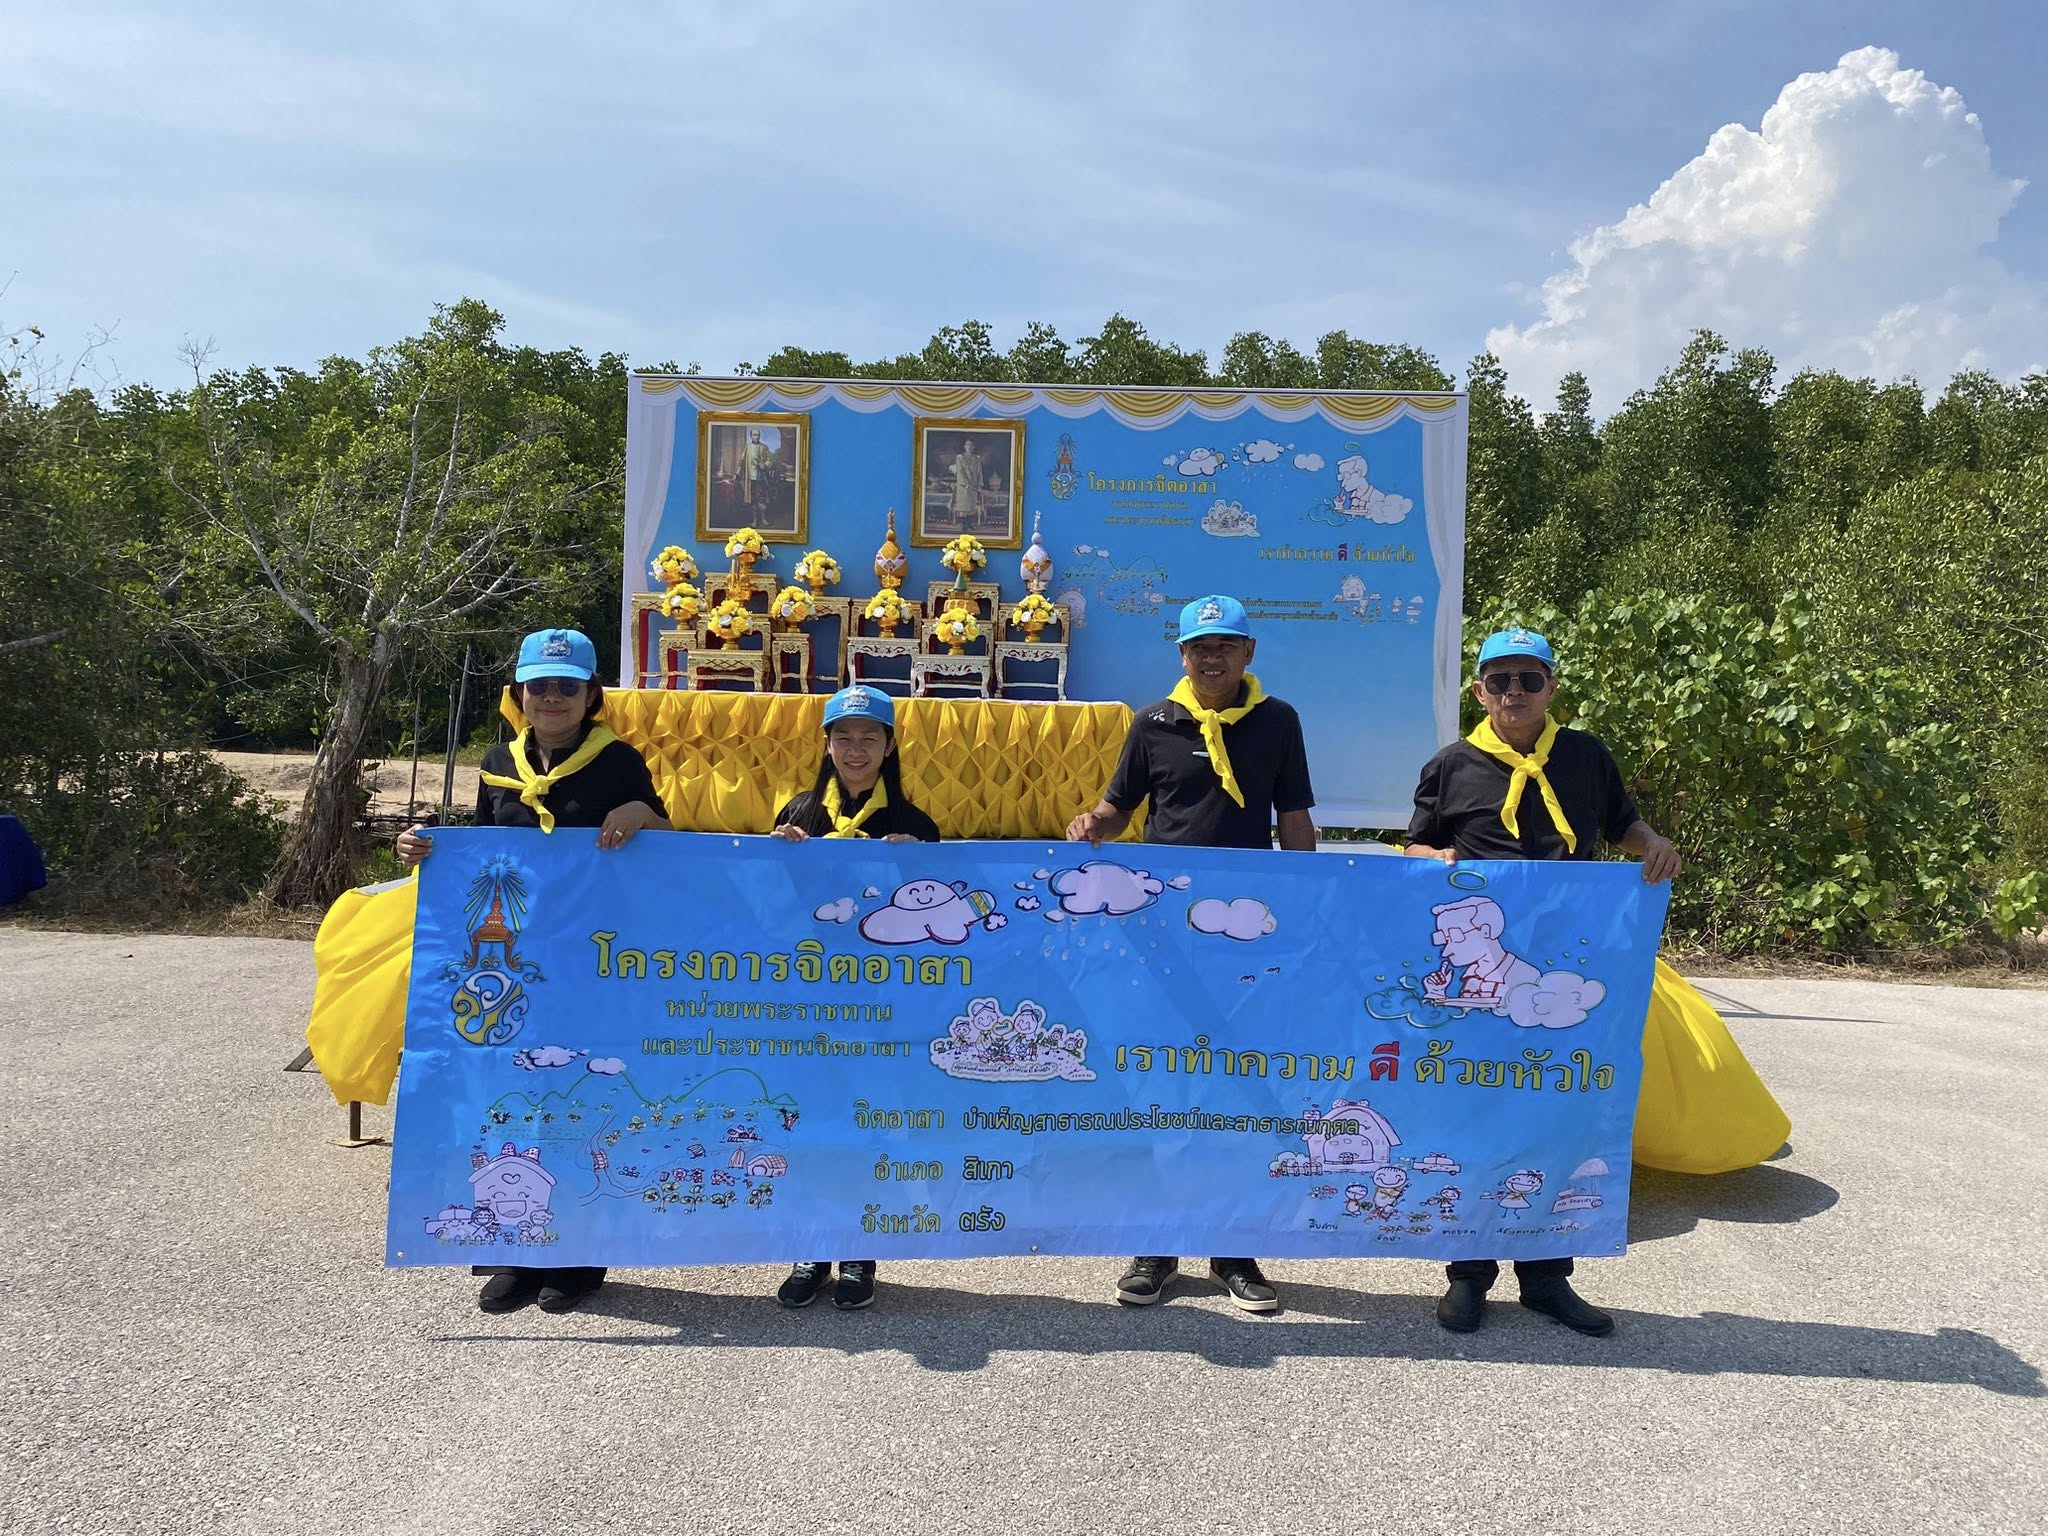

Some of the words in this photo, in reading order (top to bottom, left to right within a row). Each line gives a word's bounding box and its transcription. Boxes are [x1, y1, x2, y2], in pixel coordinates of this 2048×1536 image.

[1087, 471, 1217, 494] โครงการจิตอาสา
[590, 930, 973, 985] โครงการจิตอาสา
[666, 991, 892, 1022] หน่วยพระราชทาน
[641, 1031, 911, 1058] และประชาชนจิตอาสา
[1115, 1035, 1356, 1082] เราทำความ
[1369, 1041, 1401, 1082] ดี
[1415, 1040, 1616, 1092] ด้วยหัวใจ
[854, 1099, 944, 1129] จิตอาสา
[963, 1103, 1360, 1138] บำเพ็ญสาธารณประโยชน์และสาธารณกุศล
[875, 1153, 943, 1181] อำเภอ
[962, 1156, 1014, 1181] สิเกา
[860, 1204, 942, 1234] จังหวัด
[958, 1205, 1006, 1232] ตรัง
